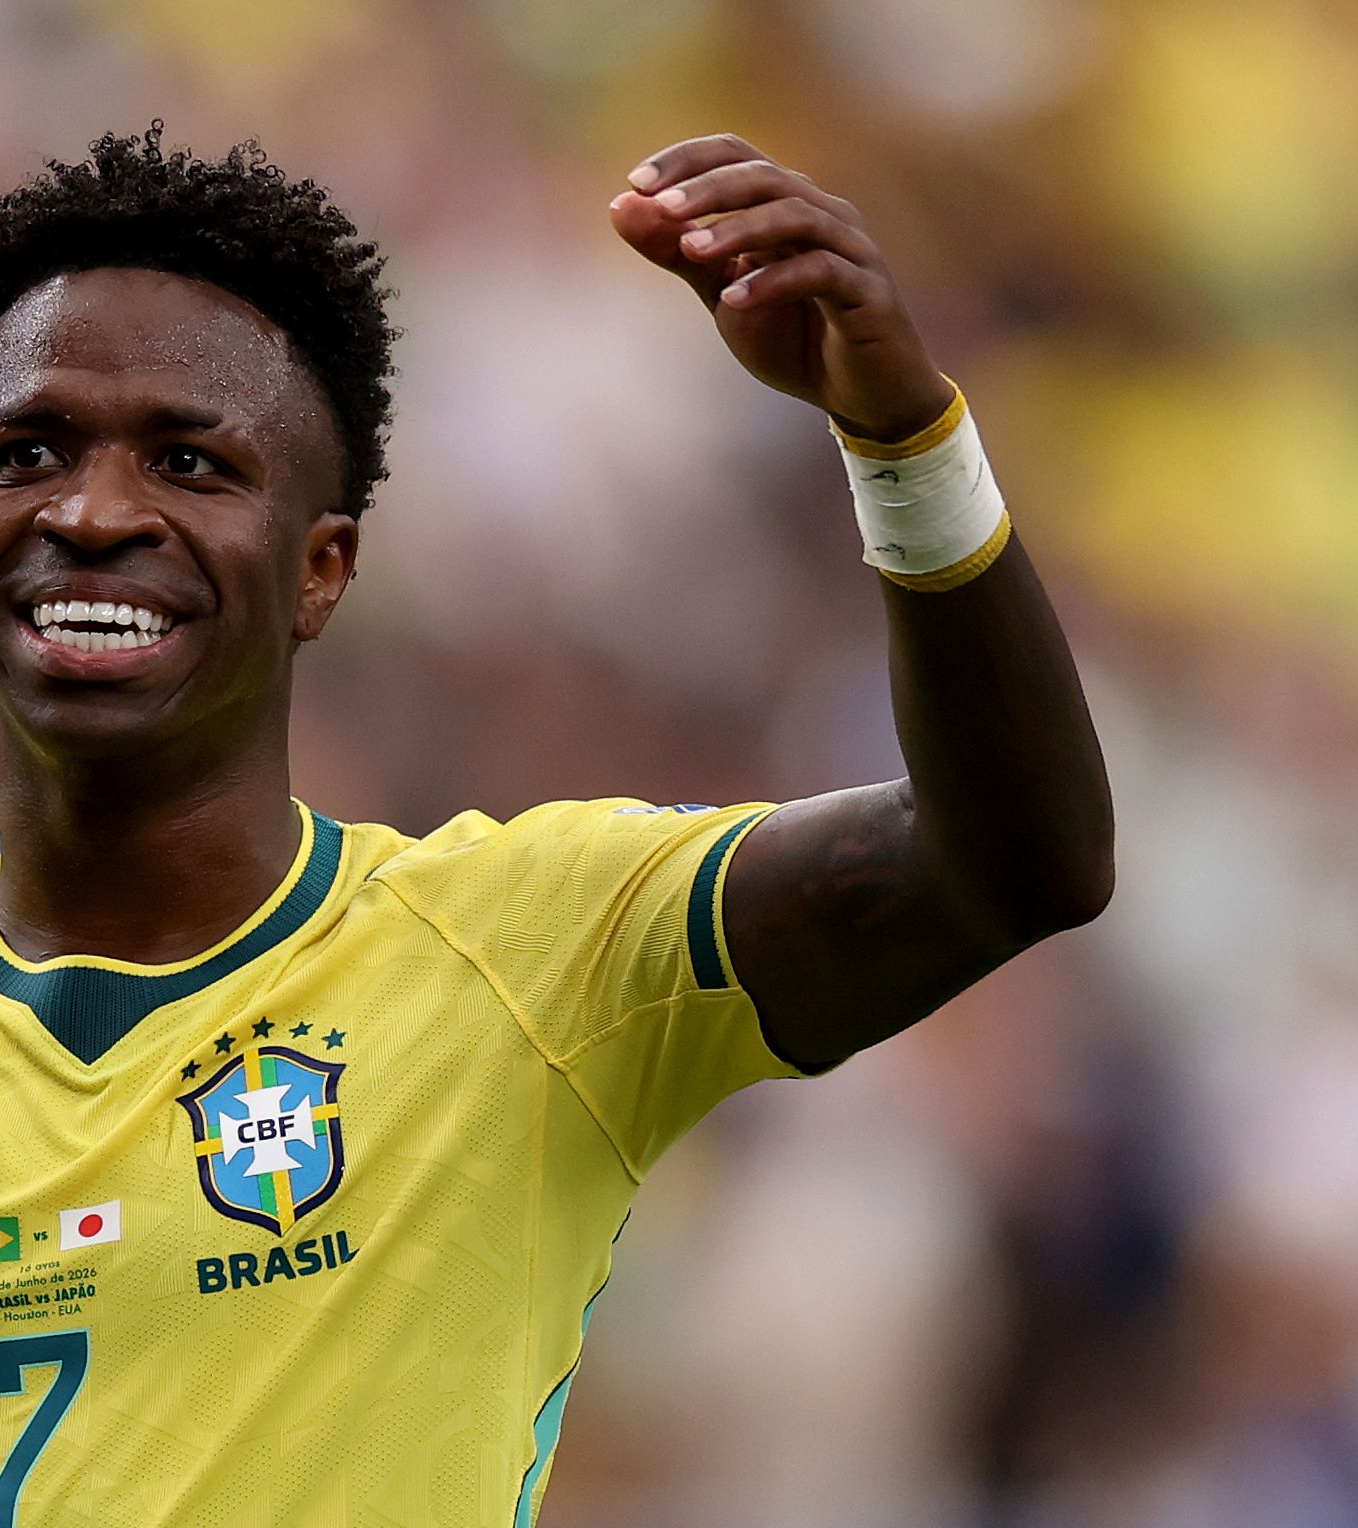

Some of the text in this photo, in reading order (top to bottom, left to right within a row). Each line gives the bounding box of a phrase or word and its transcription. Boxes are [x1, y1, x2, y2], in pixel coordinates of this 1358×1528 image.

[237, 1115, 295, 1144] CBF
[33, 1231, 48, 1242] vs
[35, 1261, 60, 1271] avos
[196, 1230, 360, 1294] BRASIL
[15, 1275, 47, 1289] Junho
[50, 1273, 64, 1284] de
[67, 1268, 97, 1281] 2026
[36, 1294, 50, 1304] vs
[54, 1282, 96, 1302] JAPÃO
[3, 1310, 48, 1322] Houston
[58, 1303, 82, 1317] EUA
